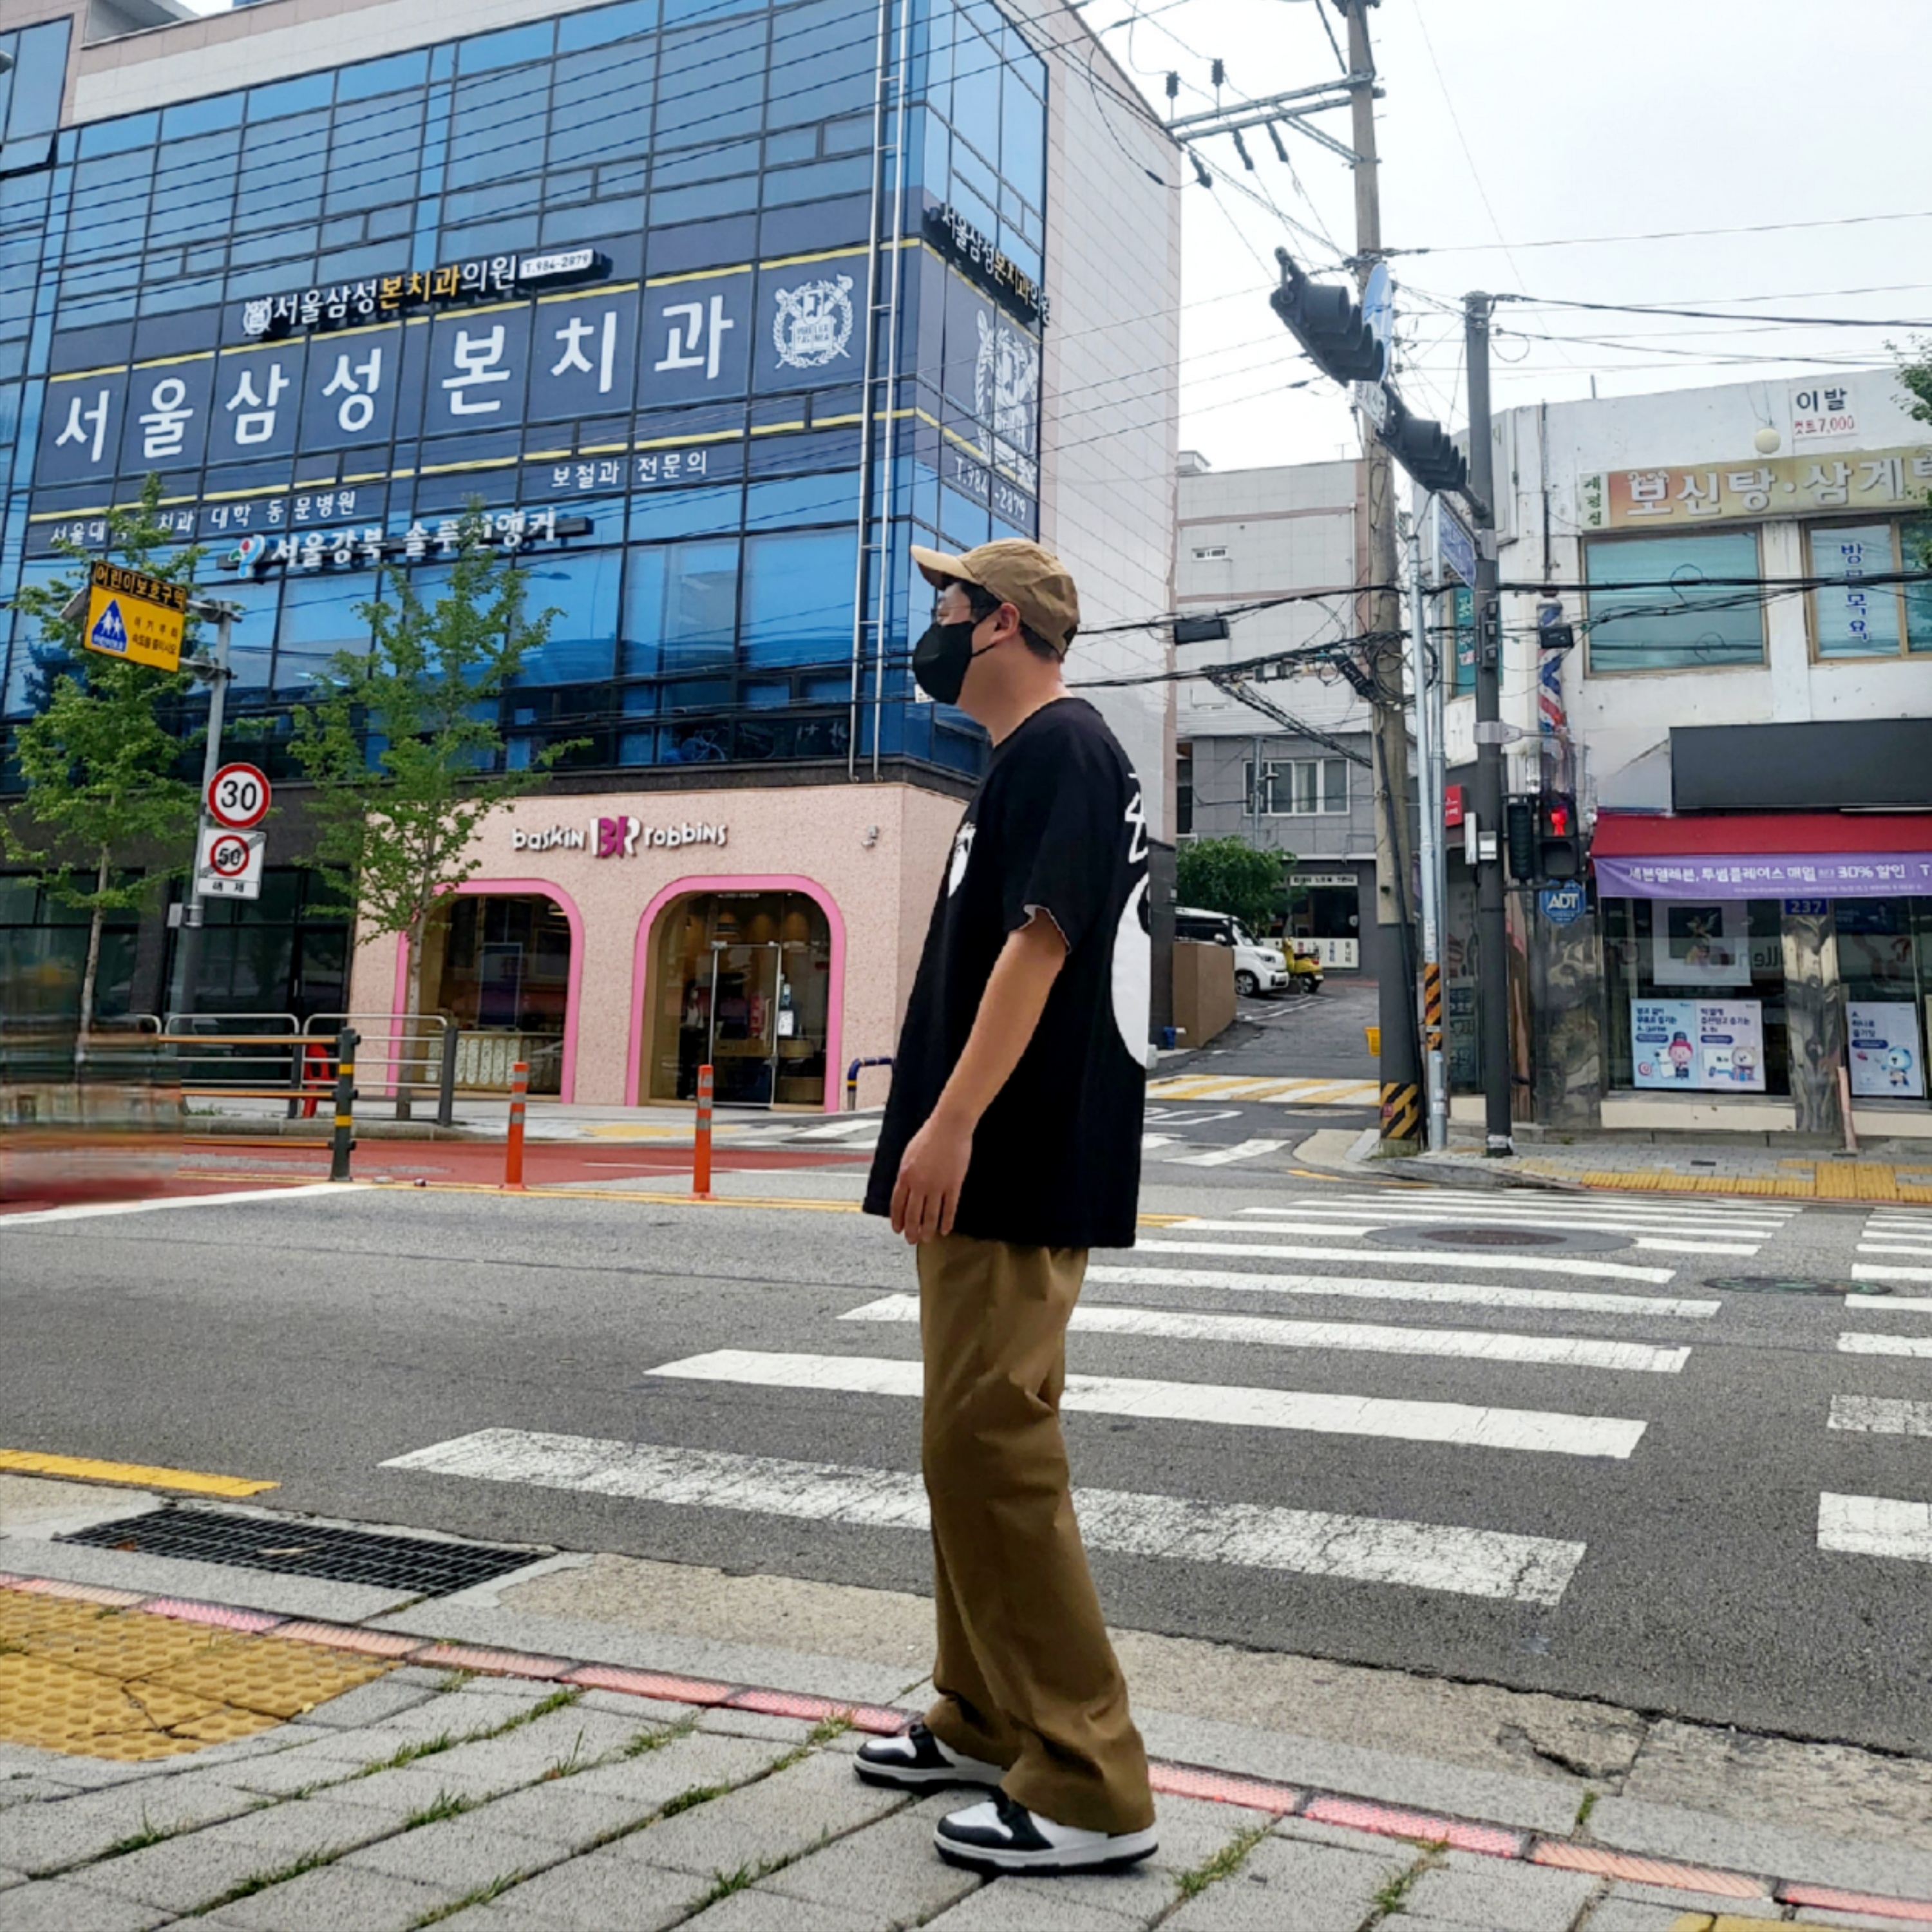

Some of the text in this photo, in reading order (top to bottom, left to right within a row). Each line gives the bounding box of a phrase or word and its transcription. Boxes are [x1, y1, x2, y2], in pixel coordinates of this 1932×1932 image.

[274, 255, 516, 325] 서울삼성본치과의원
[1796, 388, 1848, 413] 이발
[551, 450, 706, 489] 보철과 전문의
[271, 527, 387, 567] 서울강북
[95, 565, 185, 611] 어린이보호구역
[221, 780, 257, 811] 30
[512, 816, 727, 857] baskin BR robbins
[217, 848, 241, 866] 50
[1837, 866, 1874, 878] 30%
[1875, 864, 1906, 880] 할인
[1548, 893, 1578, 909] ADT
[1791, 900, 1822, 913] 237
